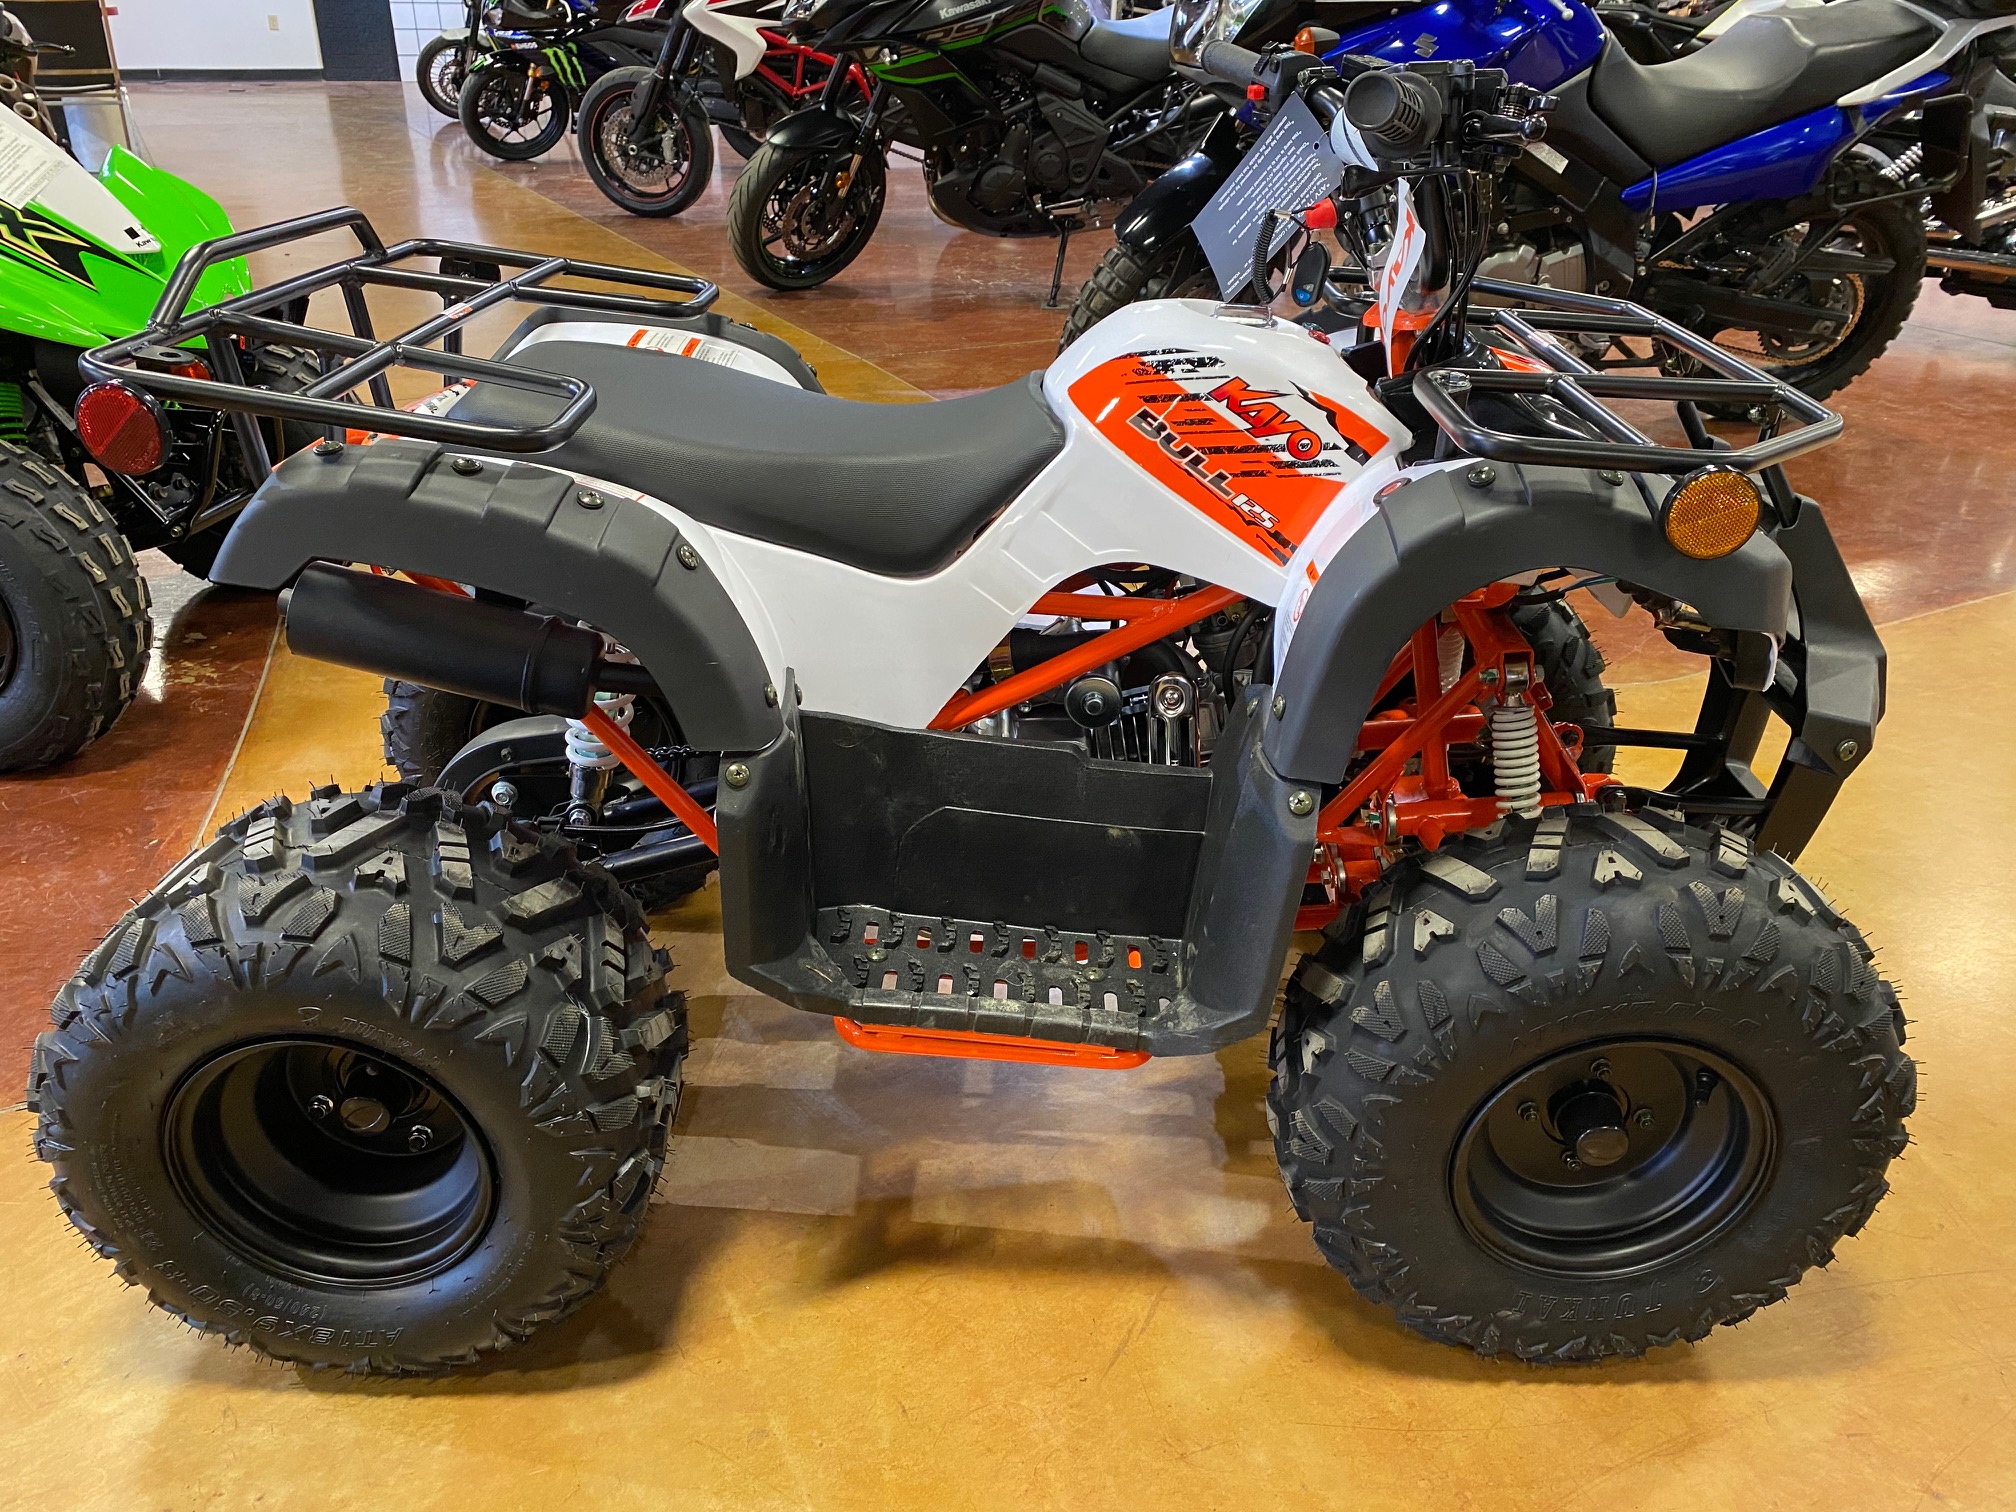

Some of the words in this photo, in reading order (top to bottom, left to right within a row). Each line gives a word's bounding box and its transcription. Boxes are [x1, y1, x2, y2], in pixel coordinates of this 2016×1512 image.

[938, 0, 992, 20] Kawasaki
[1263, 134, 1274, 146] after
[1274, 128, 1285, 140] hang
[1282, 139, 1293, 150] hang
[1247, 151, 1261, 166] vehicle
[1280, 161, 1290, 172] your
[1233, 172, 1244, 183] been
[1238, 168, 1254, 186] removed
[1253, 170, 1268, 187] removed
[1271, 170, 1283, 184] dealer
[1243, 185, 1255, 198] before
[1208, 376, 1324, 460] KAYO
[1126, 406, 1237, 500] BULL
[1231, 492, 1281, 531] 125
[1511, 1280, 1668, 1323] JUNKAI
